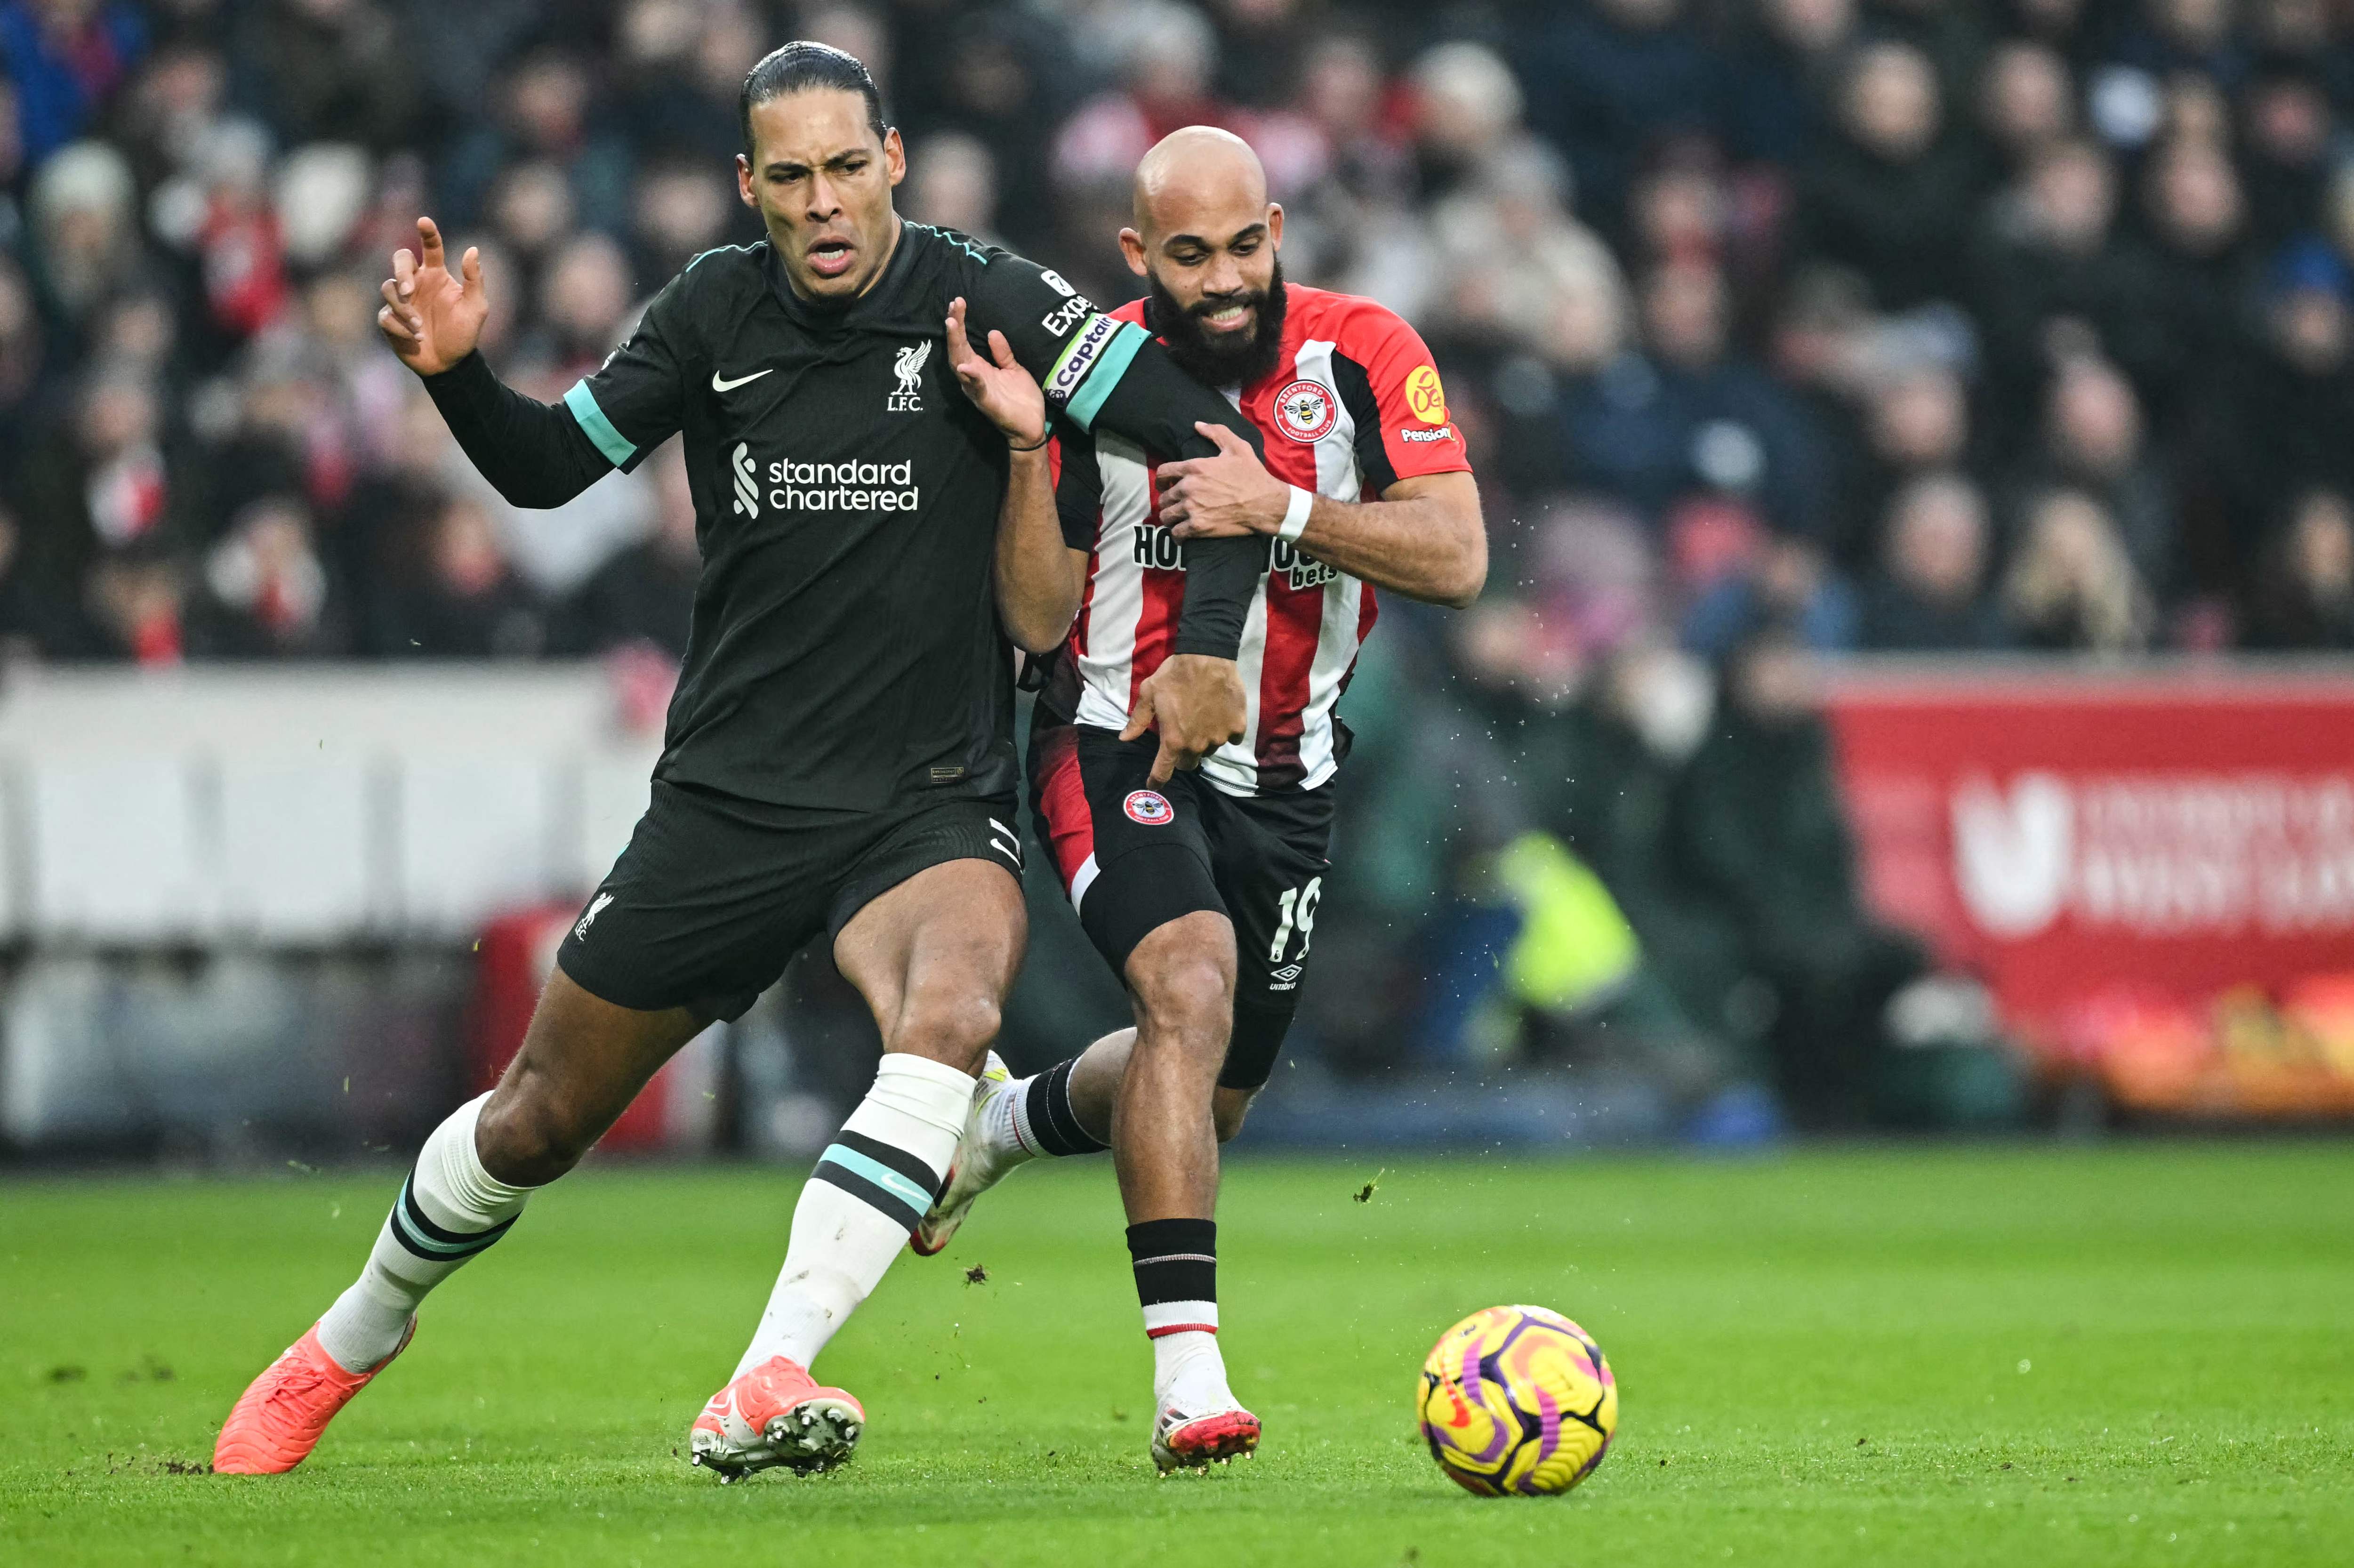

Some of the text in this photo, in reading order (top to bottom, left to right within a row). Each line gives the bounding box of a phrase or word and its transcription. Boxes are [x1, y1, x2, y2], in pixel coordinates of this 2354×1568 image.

[1042, 296, 1098, 337] Expe
[1057, 317, 1112, 386] Captain
[1280, 385, 1323, 403] BRENTFORD
[1287, 420, 1331, 438] FOOTBALL CLUB
[769, 458, 911, 485] standard
[770, 485, 919, 511] chartered
[1292, 564, 1338, 587] bets
[1269, 876, 1322, 962] 19
